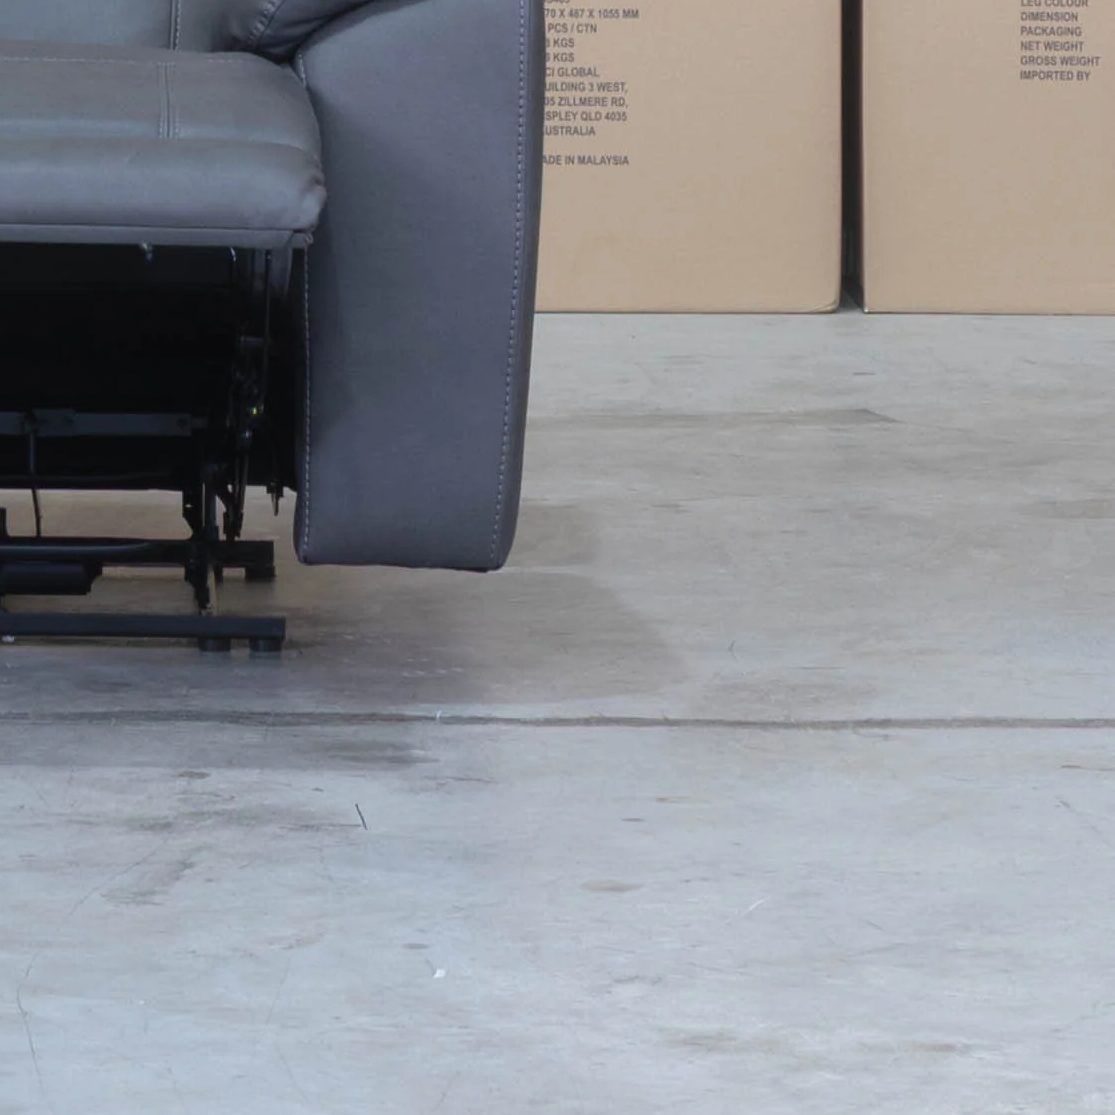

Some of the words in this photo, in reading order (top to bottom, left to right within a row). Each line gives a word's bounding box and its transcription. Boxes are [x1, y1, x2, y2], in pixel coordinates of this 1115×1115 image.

[1020, 11, 1078, 22] DIMENSION
[1020, 26, 1082, 37] PACKAGING
[1043, 41, 1086, 51] WEIGHT
[1020, 55, 1057, 66] GROSS
[1060, 56, 1101, 66] WEIGHT
[557, 67, 600, 77] GLOBAL
[1020, 70, 1074, 81] IMPORTED
[557, 96, 607, 107] ZILLMERE
[577, 155, 630, 166] MALAYSIA
